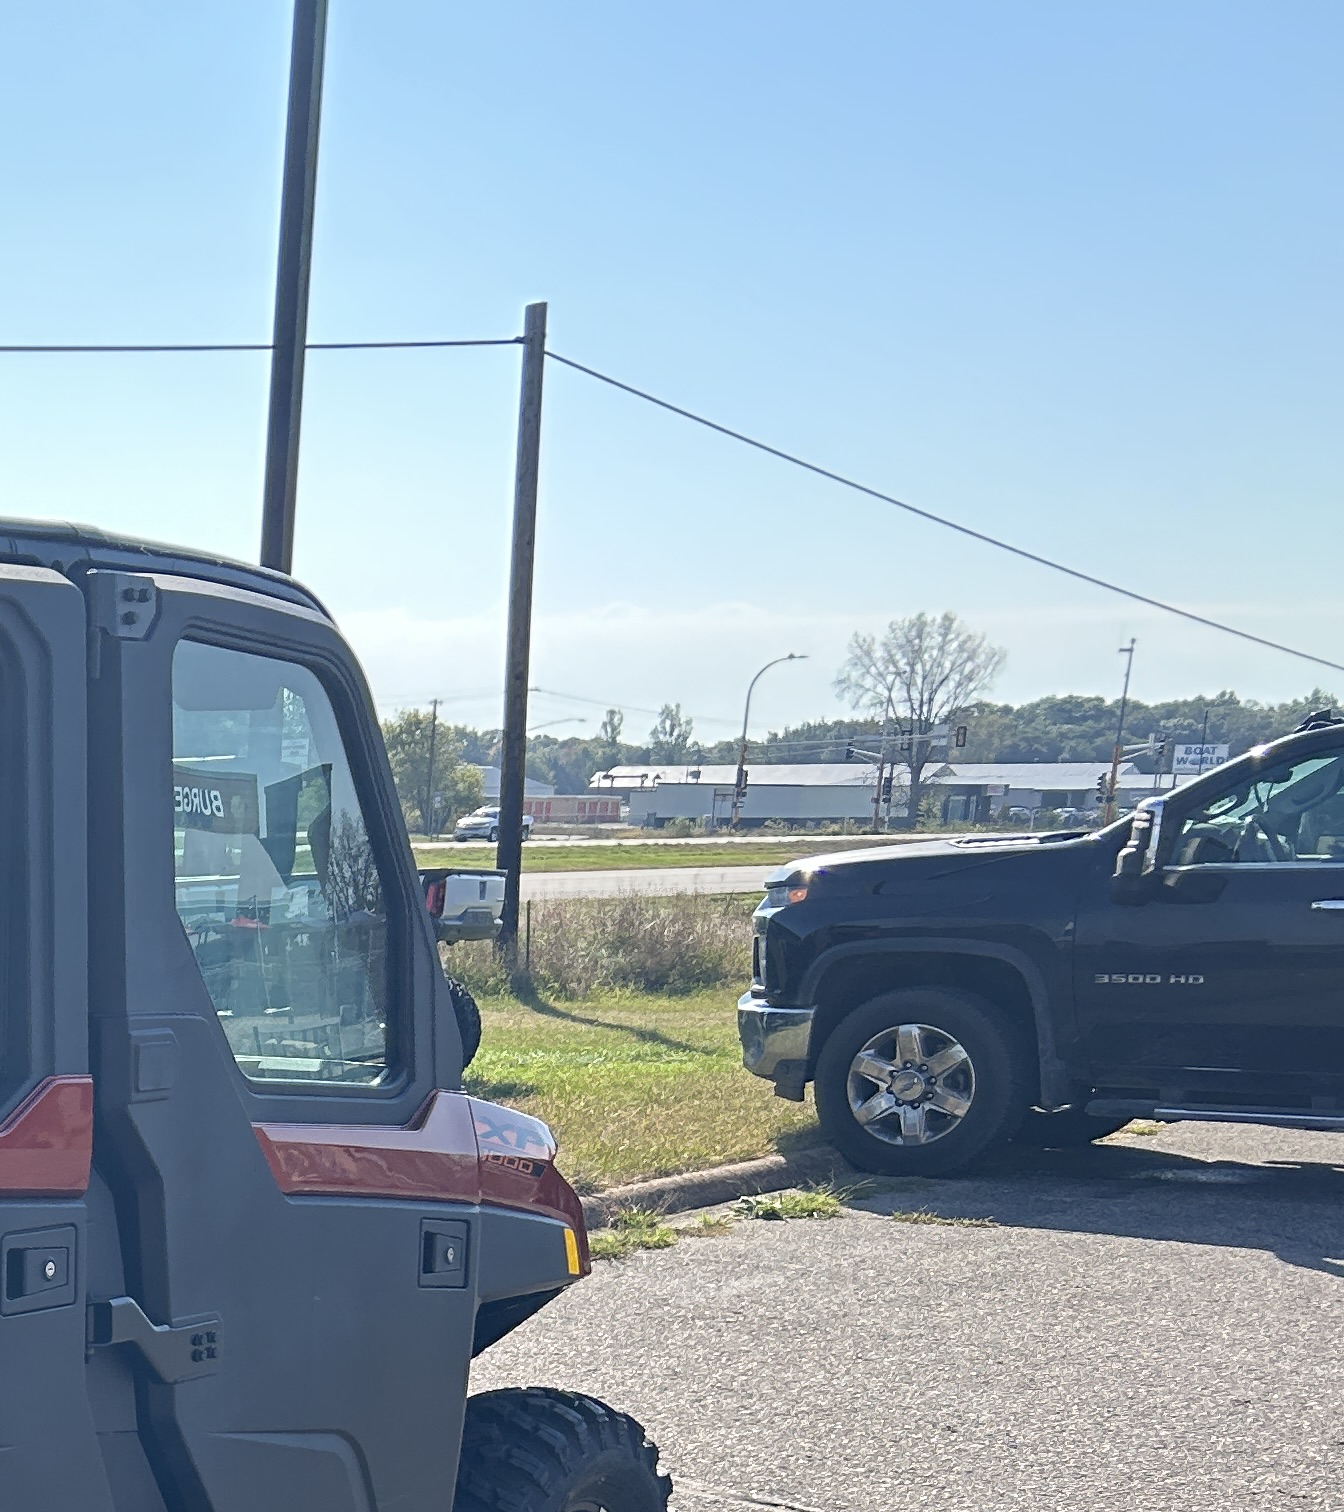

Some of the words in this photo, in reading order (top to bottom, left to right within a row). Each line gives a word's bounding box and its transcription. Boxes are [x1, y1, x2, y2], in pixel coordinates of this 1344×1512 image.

[1184, 746, 1218, 755] BOAT
[1094, 974, 1161, 984] 3500
[1169, 974, 1204, 985] HD
[478, 1115, 546, 1151] XP
